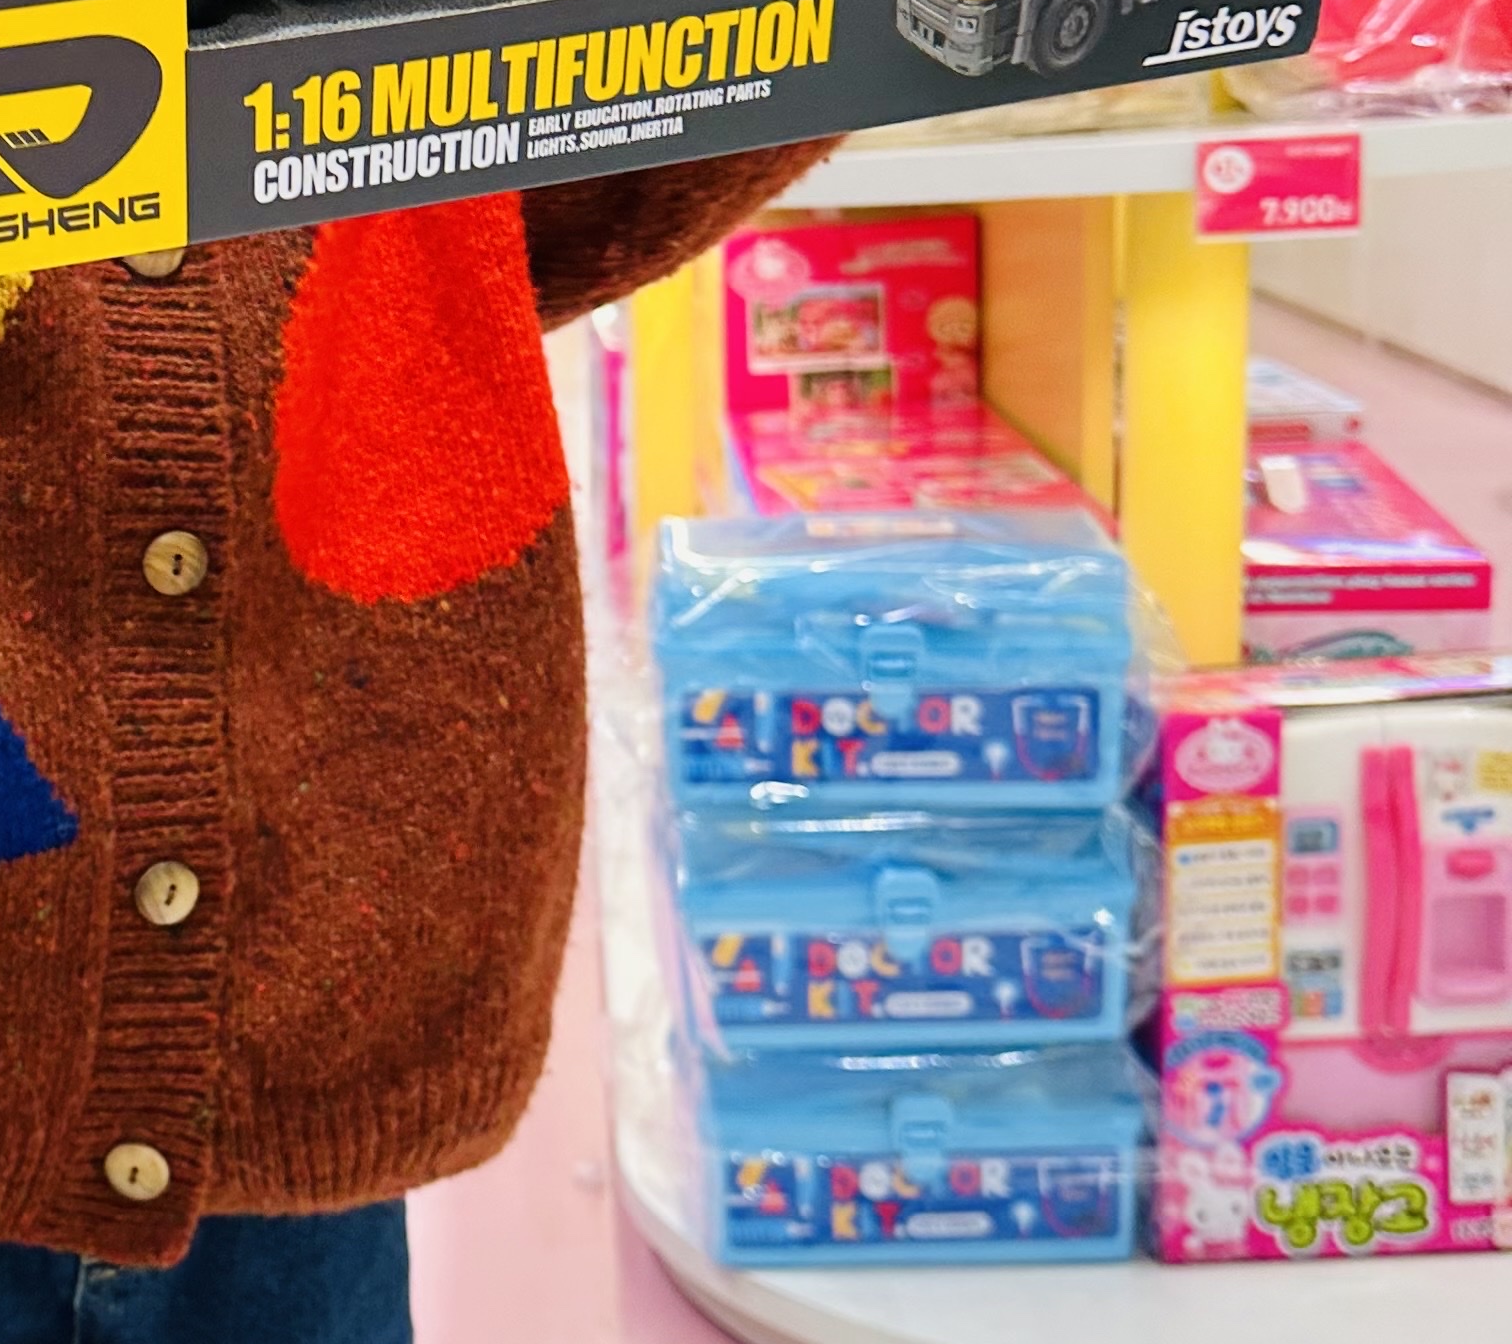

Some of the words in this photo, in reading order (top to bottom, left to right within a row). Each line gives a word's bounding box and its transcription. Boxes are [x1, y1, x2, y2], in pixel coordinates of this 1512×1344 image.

[243, 69, 362, 153] 1:16
[528, 112, 572, 137] EARLY
[726, 79, 772, 104] PARTS
[253, 121, 521, 204] CONSTRUCTION
[1260, 1180, 1430, 1249] 냉장고
